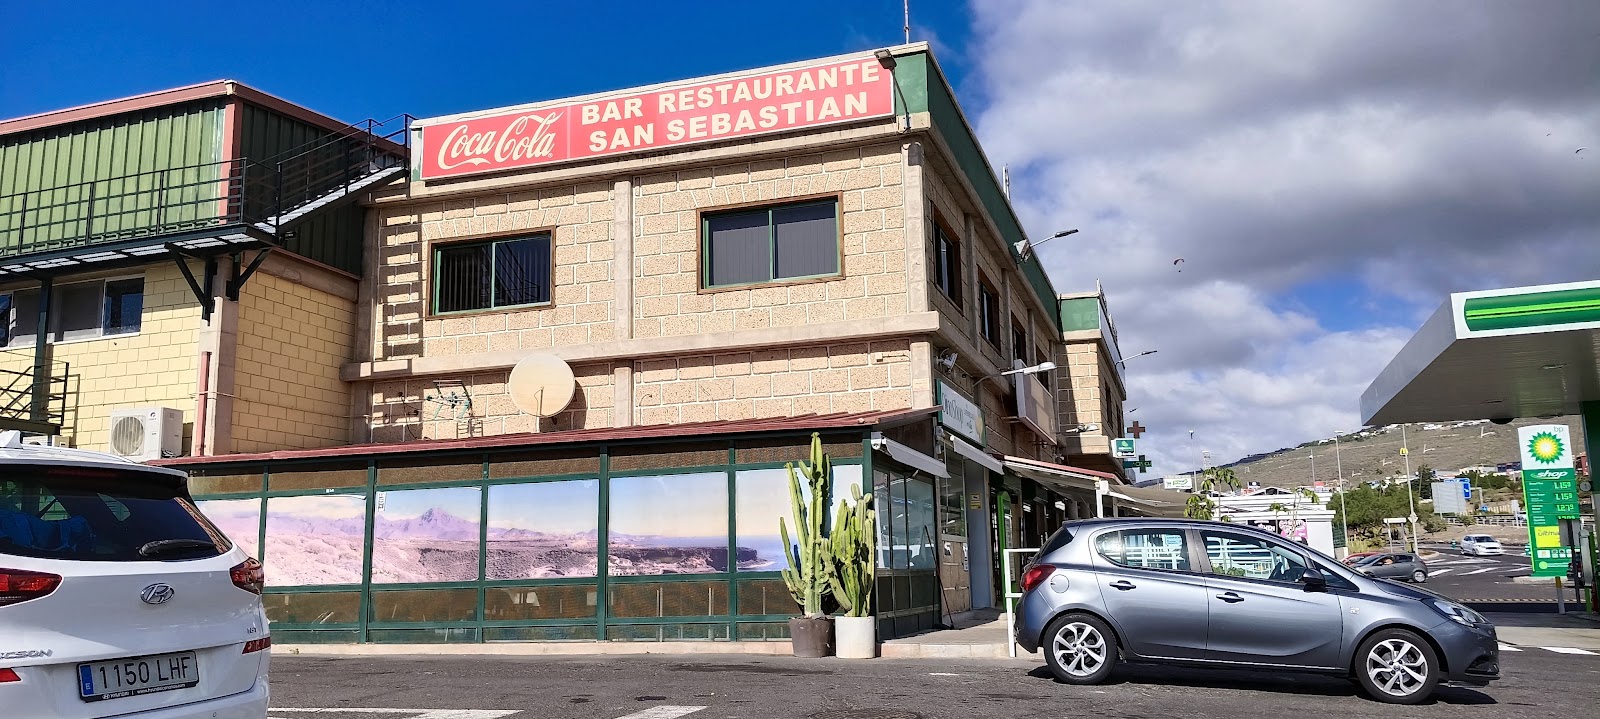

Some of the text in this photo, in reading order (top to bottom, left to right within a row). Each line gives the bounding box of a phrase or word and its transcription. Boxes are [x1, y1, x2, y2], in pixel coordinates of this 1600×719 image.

[581, 61, 880, 125] BAR RESTAURANTE
[437, 109, 566, 170] Coca Cola
[589, 91, 868, 152] SAN SEBASTIAN
[1537, 469, 1568, 479] shop
[85, 682, 91, 690] E
[99, 656, 191, 689] 1150 LHF
